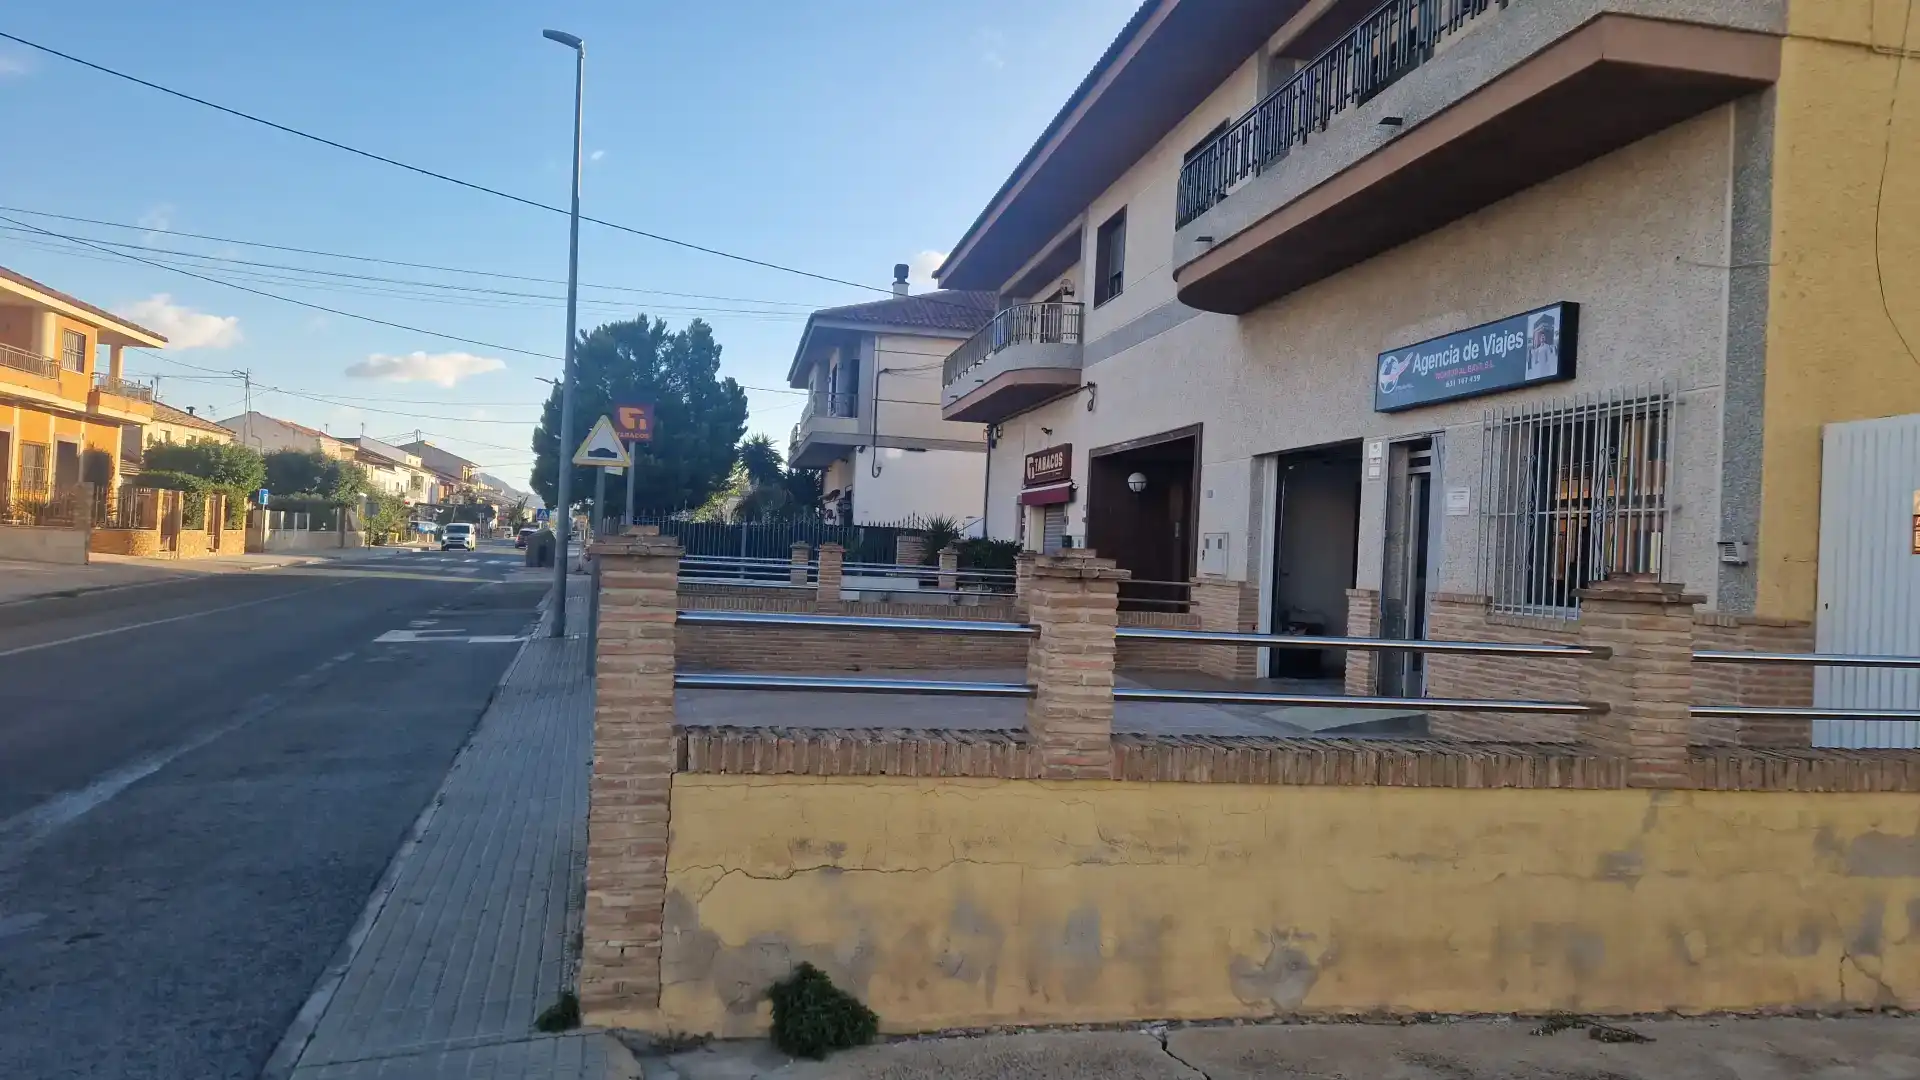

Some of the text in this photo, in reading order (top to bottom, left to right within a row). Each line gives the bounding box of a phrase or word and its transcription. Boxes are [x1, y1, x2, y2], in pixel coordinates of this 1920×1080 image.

[1413, 330, 1524, 376] Agencia de Viajes
[1035, 452, 1063, 472] TABACOS
